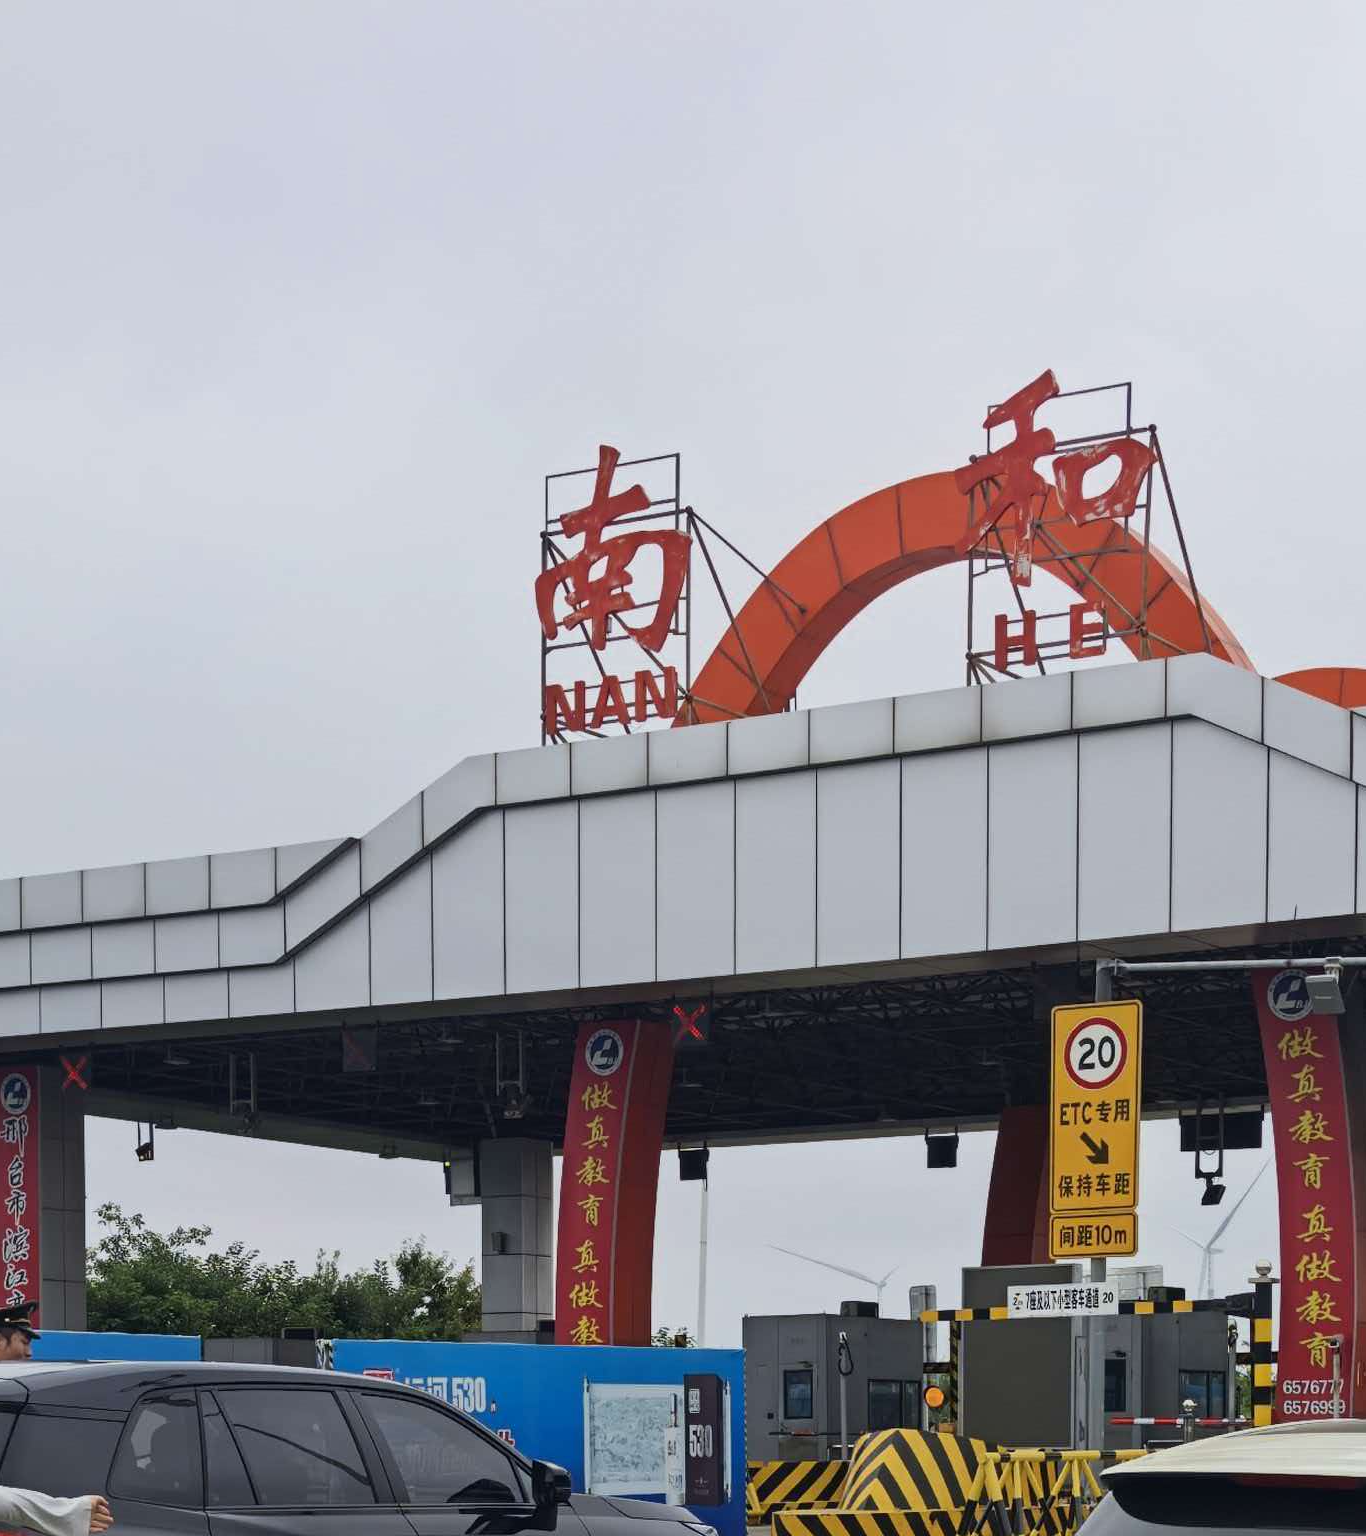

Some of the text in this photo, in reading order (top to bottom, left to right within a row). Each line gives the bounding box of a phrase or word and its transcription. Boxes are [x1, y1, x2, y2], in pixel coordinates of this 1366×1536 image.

[535, 368, 1158, 653] 南 和
[995, 600, 1107, 672] HE
[545, 665, 678, 736] NAN
[1078, 1035, 1116, 1070] 20
[1059, 1098, 1130, 1126] ETC专用
[1058, 1172, 1130, 1198] 保持车距
[1059, 1224, 1127, 1248] 间距10m
[1102, 1291, 1114, 1304] 20
[689, 1424, 714, 1458] 530
